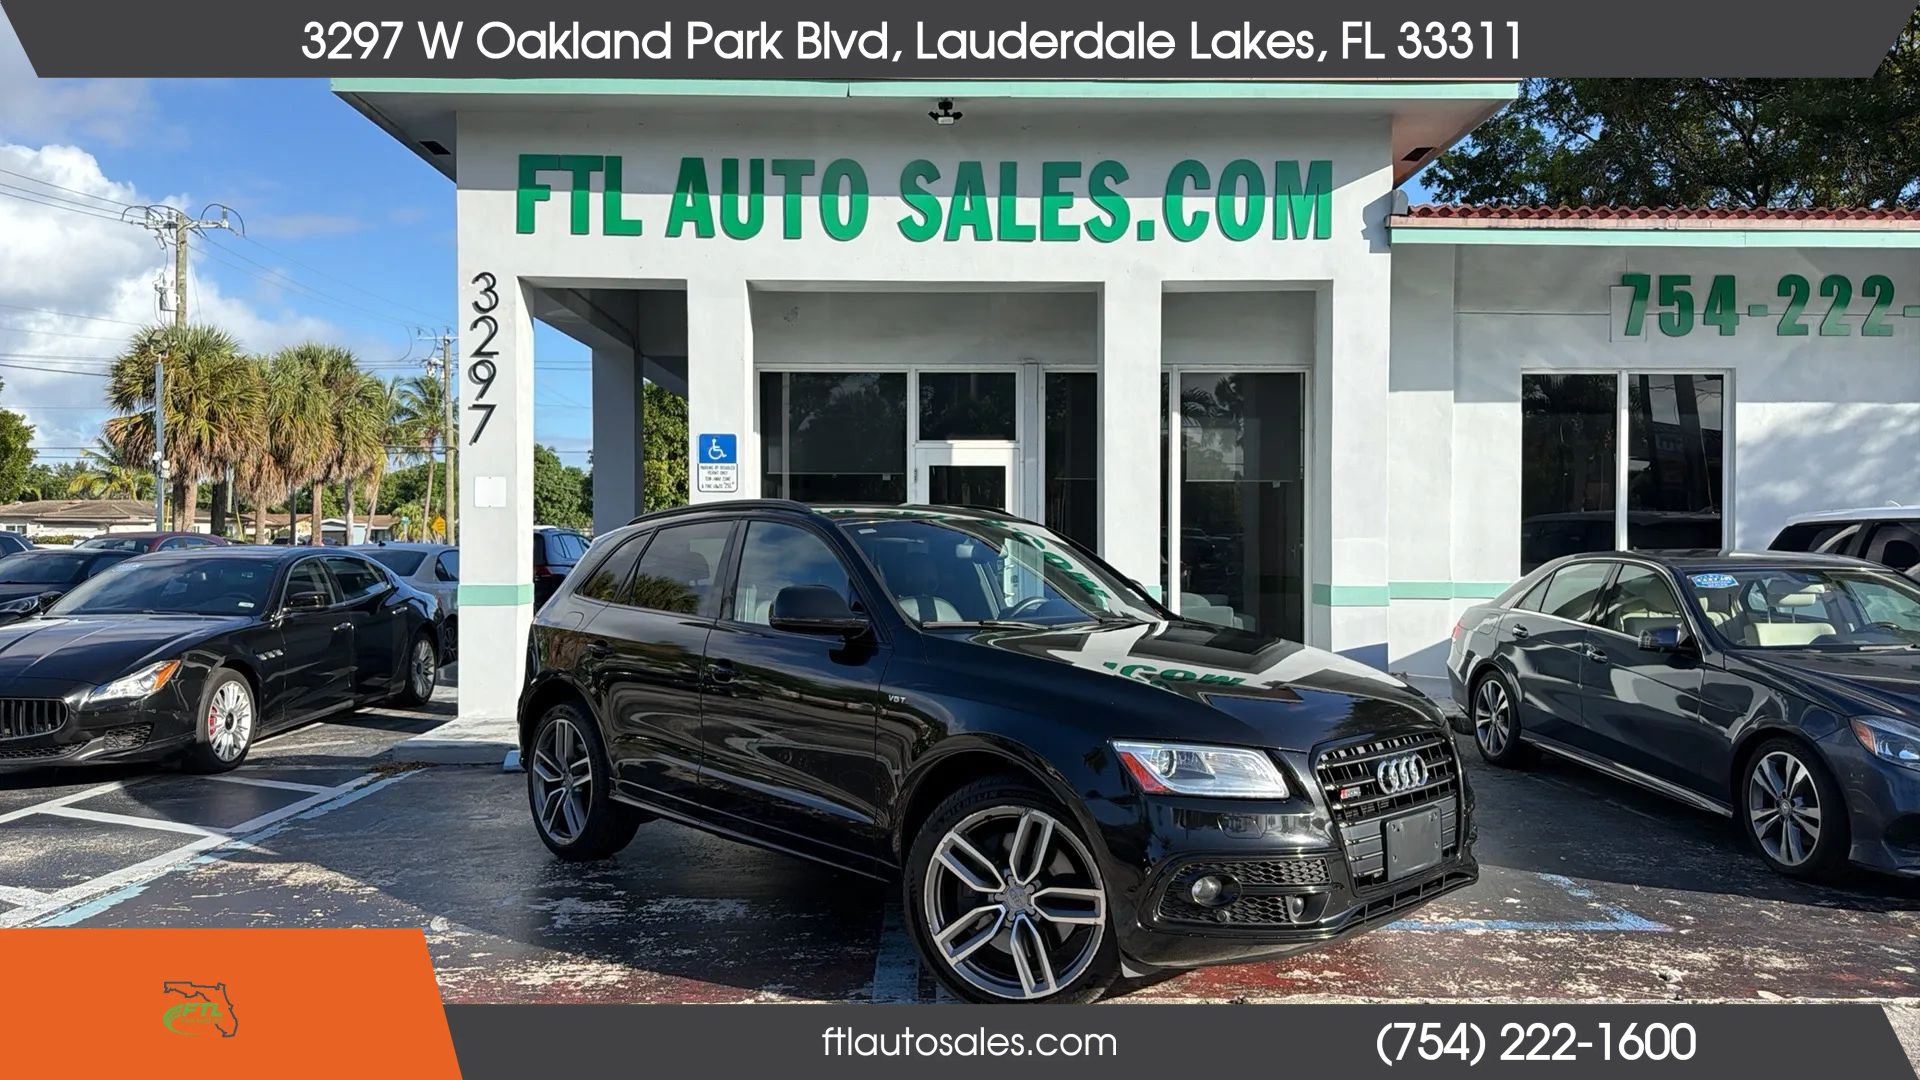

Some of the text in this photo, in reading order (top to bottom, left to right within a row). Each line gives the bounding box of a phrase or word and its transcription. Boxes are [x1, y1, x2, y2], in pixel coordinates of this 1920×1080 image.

[516, 153, 1334, 244] FTL AUTO SALES.COM
[467, 271, 500, 446] 3297
